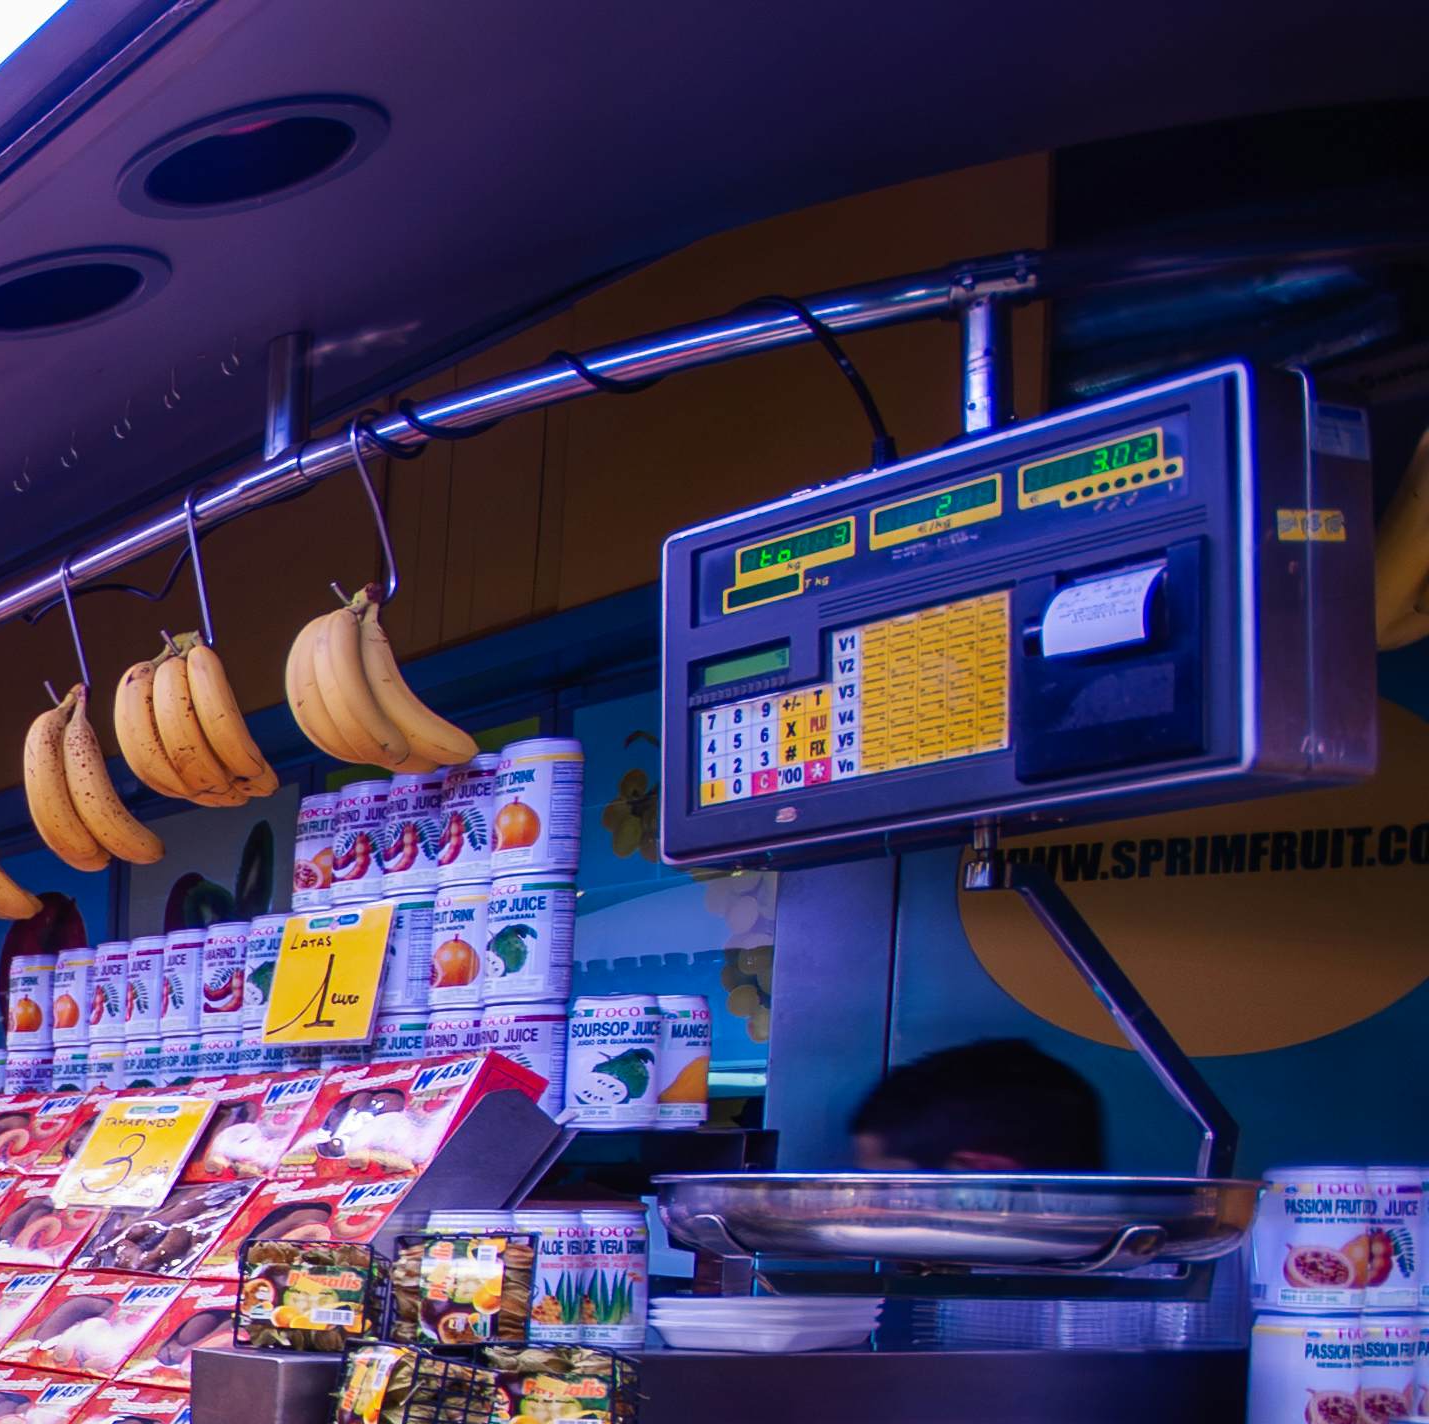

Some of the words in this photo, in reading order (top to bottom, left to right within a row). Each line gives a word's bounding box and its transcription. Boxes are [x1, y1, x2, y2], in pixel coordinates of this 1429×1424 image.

[838, 634, 856, 653] V1
[838, 658, 855, 675] V2
[838, 684, 855, 700] V3
[707, 714, 717, 731] 7
[733, 709, 743, 724] 8
[761, 702, 771, 717] 9
[813, 689, 823, 706] T
[838, 710, 855, 726] V4
[707, 739, 717, 754] 4
[733, 733, 742, 749] 5
[760, 727, 770, 743] 6
[785, 721, 797, 738] X
[838, 731, 855, 748] V5
[707, 763, 717, 778] 1
[733, 757, 743, 774] 2
[760, 751, 770, 766] 3
[809, 739, 826, 757] FIX
[510, 768, 536, 786] DRINK
[733, 778, 743, 794] 0
[759, 773, 770, 789] C
[458, 782, 492, 799] JUICE
[508, 895, 547, 912] JUICE
[449, 907, 476, 924] DRINK
[289, 933, 332, 951] LATAS
[264, 953, 336, 1036] 1
[594, 1006, 641, 1018] FOCO
[503, 1027, 539, 1043] JUICE
[571, 1021, 630, 1038] SOURSOP
[632, 1020, 661, 1036] JUICE
[671, 1023, 709, 1039] MANGO
[388, 1035, 422, 1050] JUICE
[413, 1059, 475, 1093] WABU
[264, 1075, 322, 1106] WABU
[39, 1094, 85, 1116] WABU
[102, 1115, 178, 1129] TAMARINDO
[80, 1132, 147, 1194] 3
[343, 1179, 408, 1206] WABU
[1284, 1198, 1333, 1216] PASSION
[1384, 1200, 1419, 1217] JUICE
[588, 1226, 635, 1238] FOCO
[541, 1239, 564, 1255] ALOE
[600, 1240, 624, 1255] VERA
[4, 1271, 58, 1293] WABU
[123, 1283, 183, 1304] WABU
[1304, 1342, 1351, 1360] PASSION
[41, 1383, 96, 1403] WABU
